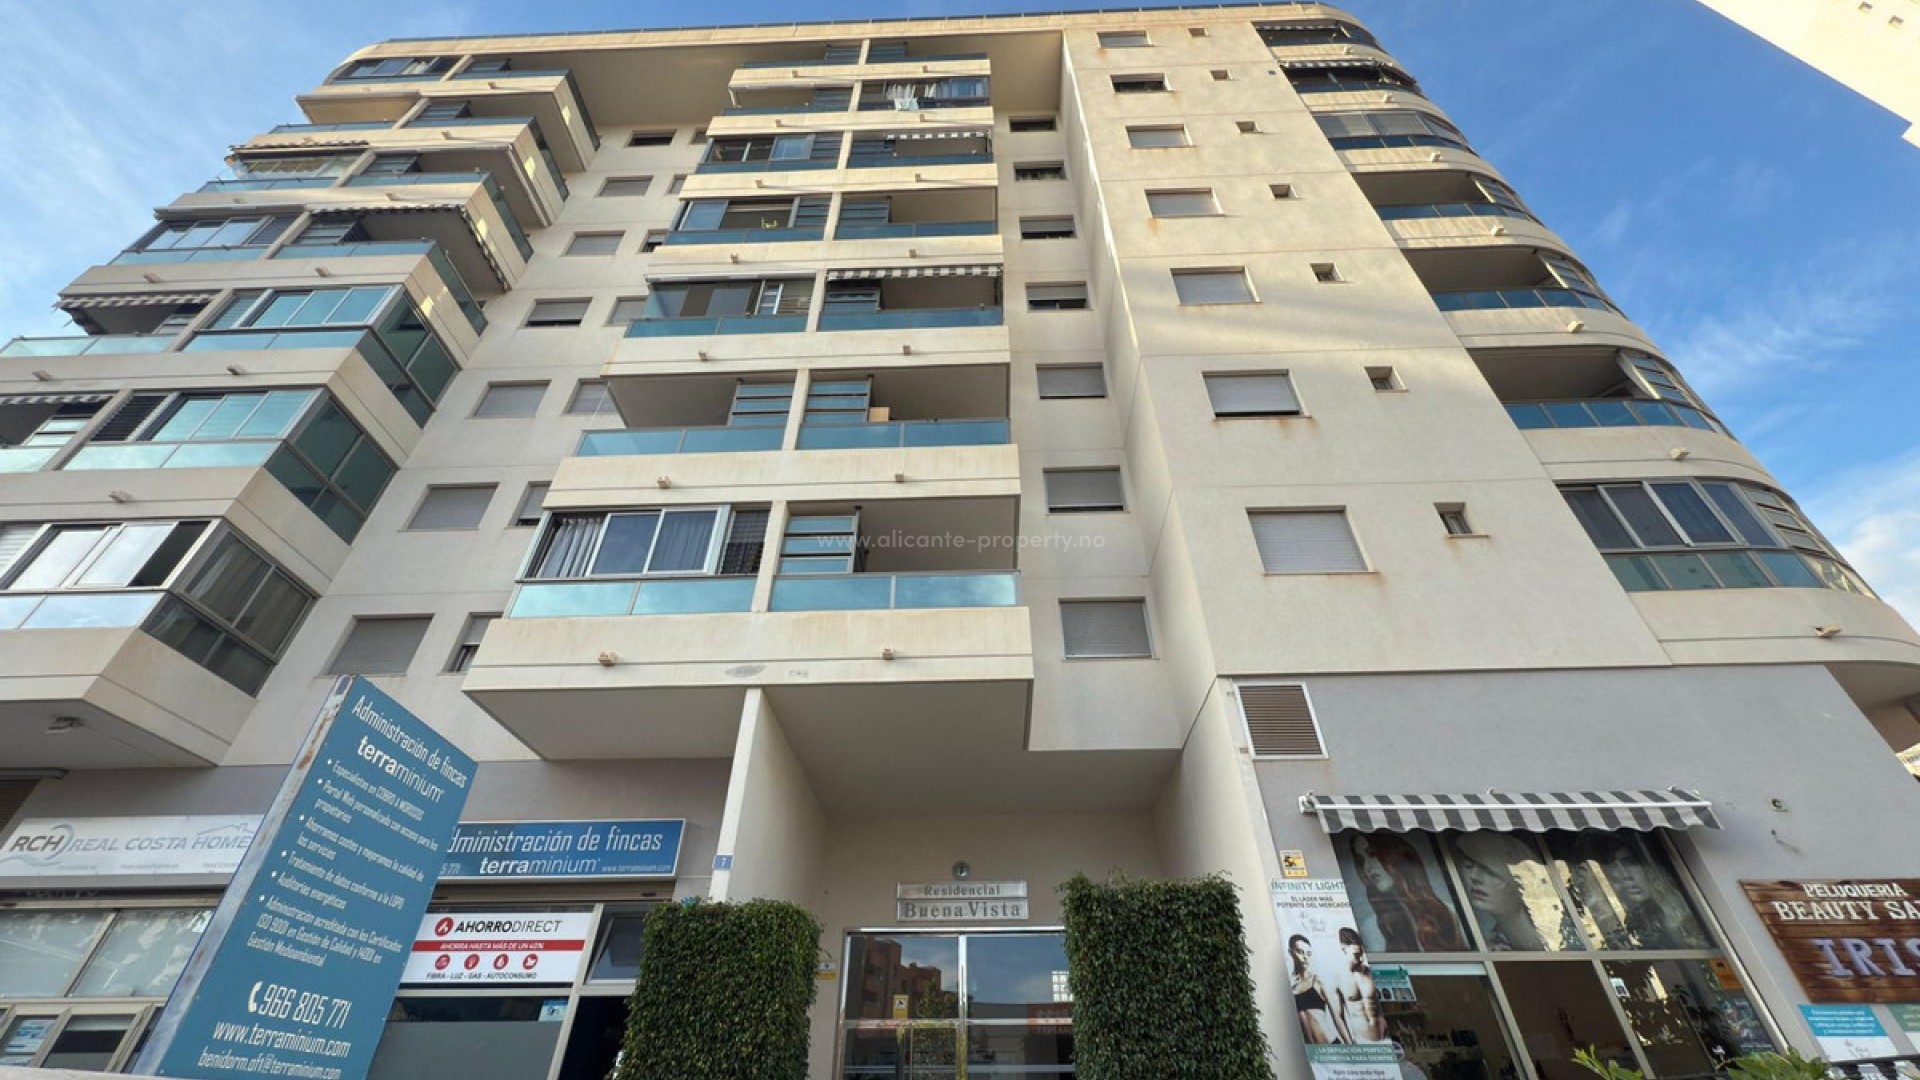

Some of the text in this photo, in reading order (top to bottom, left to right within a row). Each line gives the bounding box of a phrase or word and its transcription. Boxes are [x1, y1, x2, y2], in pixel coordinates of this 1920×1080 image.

[352, 695, 467, 788] Administración de fincas
[357, 735, 441, 802] terraminium
[10, 836, 252, 851] RCH REAL COSTA HOME
[447, 825, 662, 852] dministración de fincas
[480, 856, 597, 875] terraminium
[924, 884, 1000, 896] Residencial
[1271, 881, 1346, 891] INFINITY LIGHT
[904, 901, 1020, 918] Buena Vista
[1772, 901, 1920, 920] BEAUTY SA
[455, 920, 563, 933] AHORRODIRECT
[486, 971, 537, 980] AUTOCONSUMO
[257, 984, 352, 1028] 966 805 771
[213, 1022, 351, 1057] www.terraminium.com
